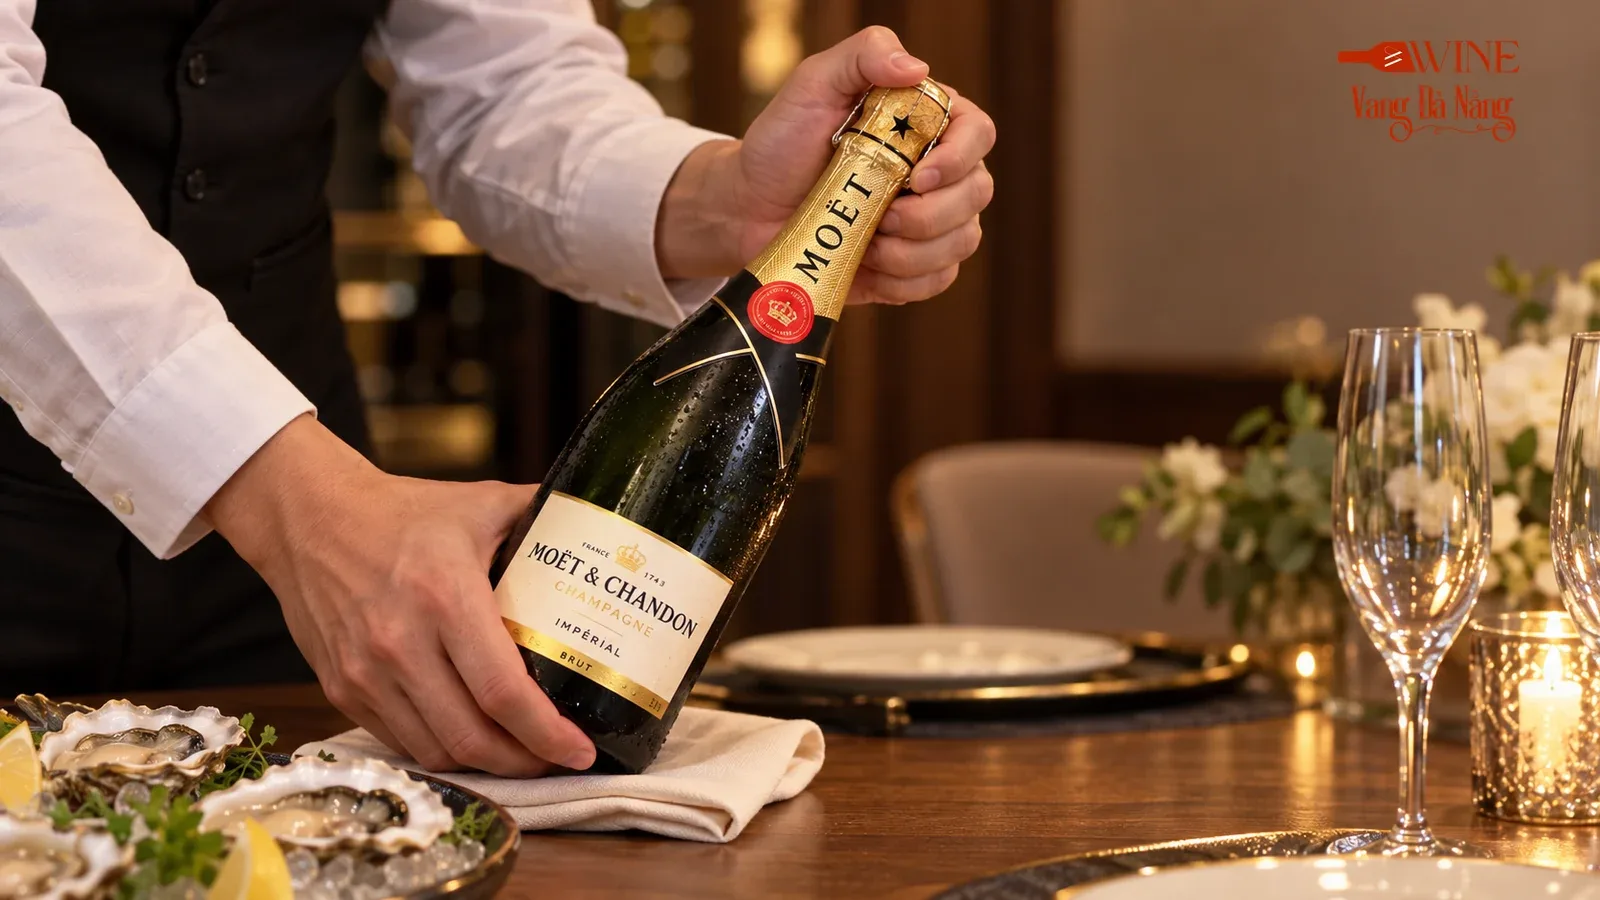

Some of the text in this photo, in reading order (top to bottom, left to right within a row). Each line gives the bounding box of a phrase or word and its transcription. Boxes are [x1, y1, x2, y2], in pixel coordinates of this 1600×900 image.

[793, 172, 873, 284] MOËT
[527, 541, 698, 639] MOËT & CHANDON
[582, 541, 666, 587] FRANCE 1743
[555, 580, 654, 638] CHAMPAGNE
[555, 618, 621, 658] IMPÉRIAL
[559, 651, 593, 671] BRUT
